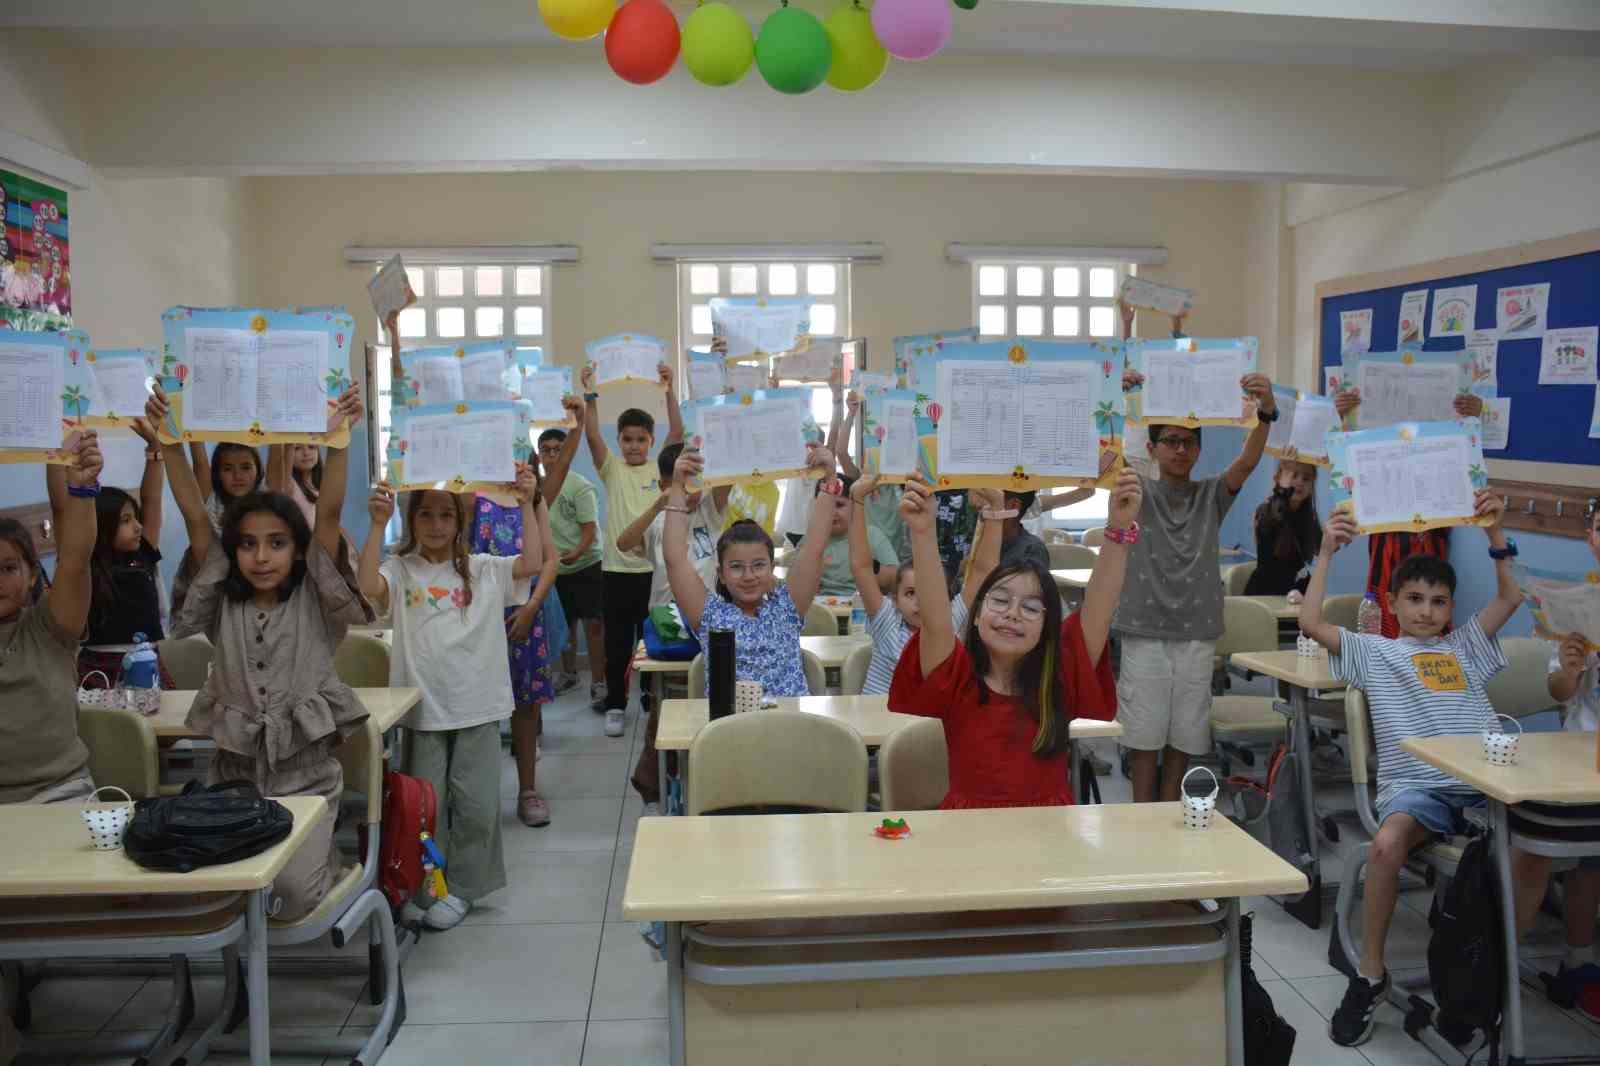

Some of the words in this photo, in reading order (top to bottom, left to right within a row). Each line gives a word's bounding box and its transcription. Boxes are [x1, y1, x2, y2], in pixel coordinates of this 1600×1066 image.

[1419, 659, 1453, 669] SKATE
[1423, 668, 1440, 677] ALL
[1439, 674, 1458, 684] DAY
